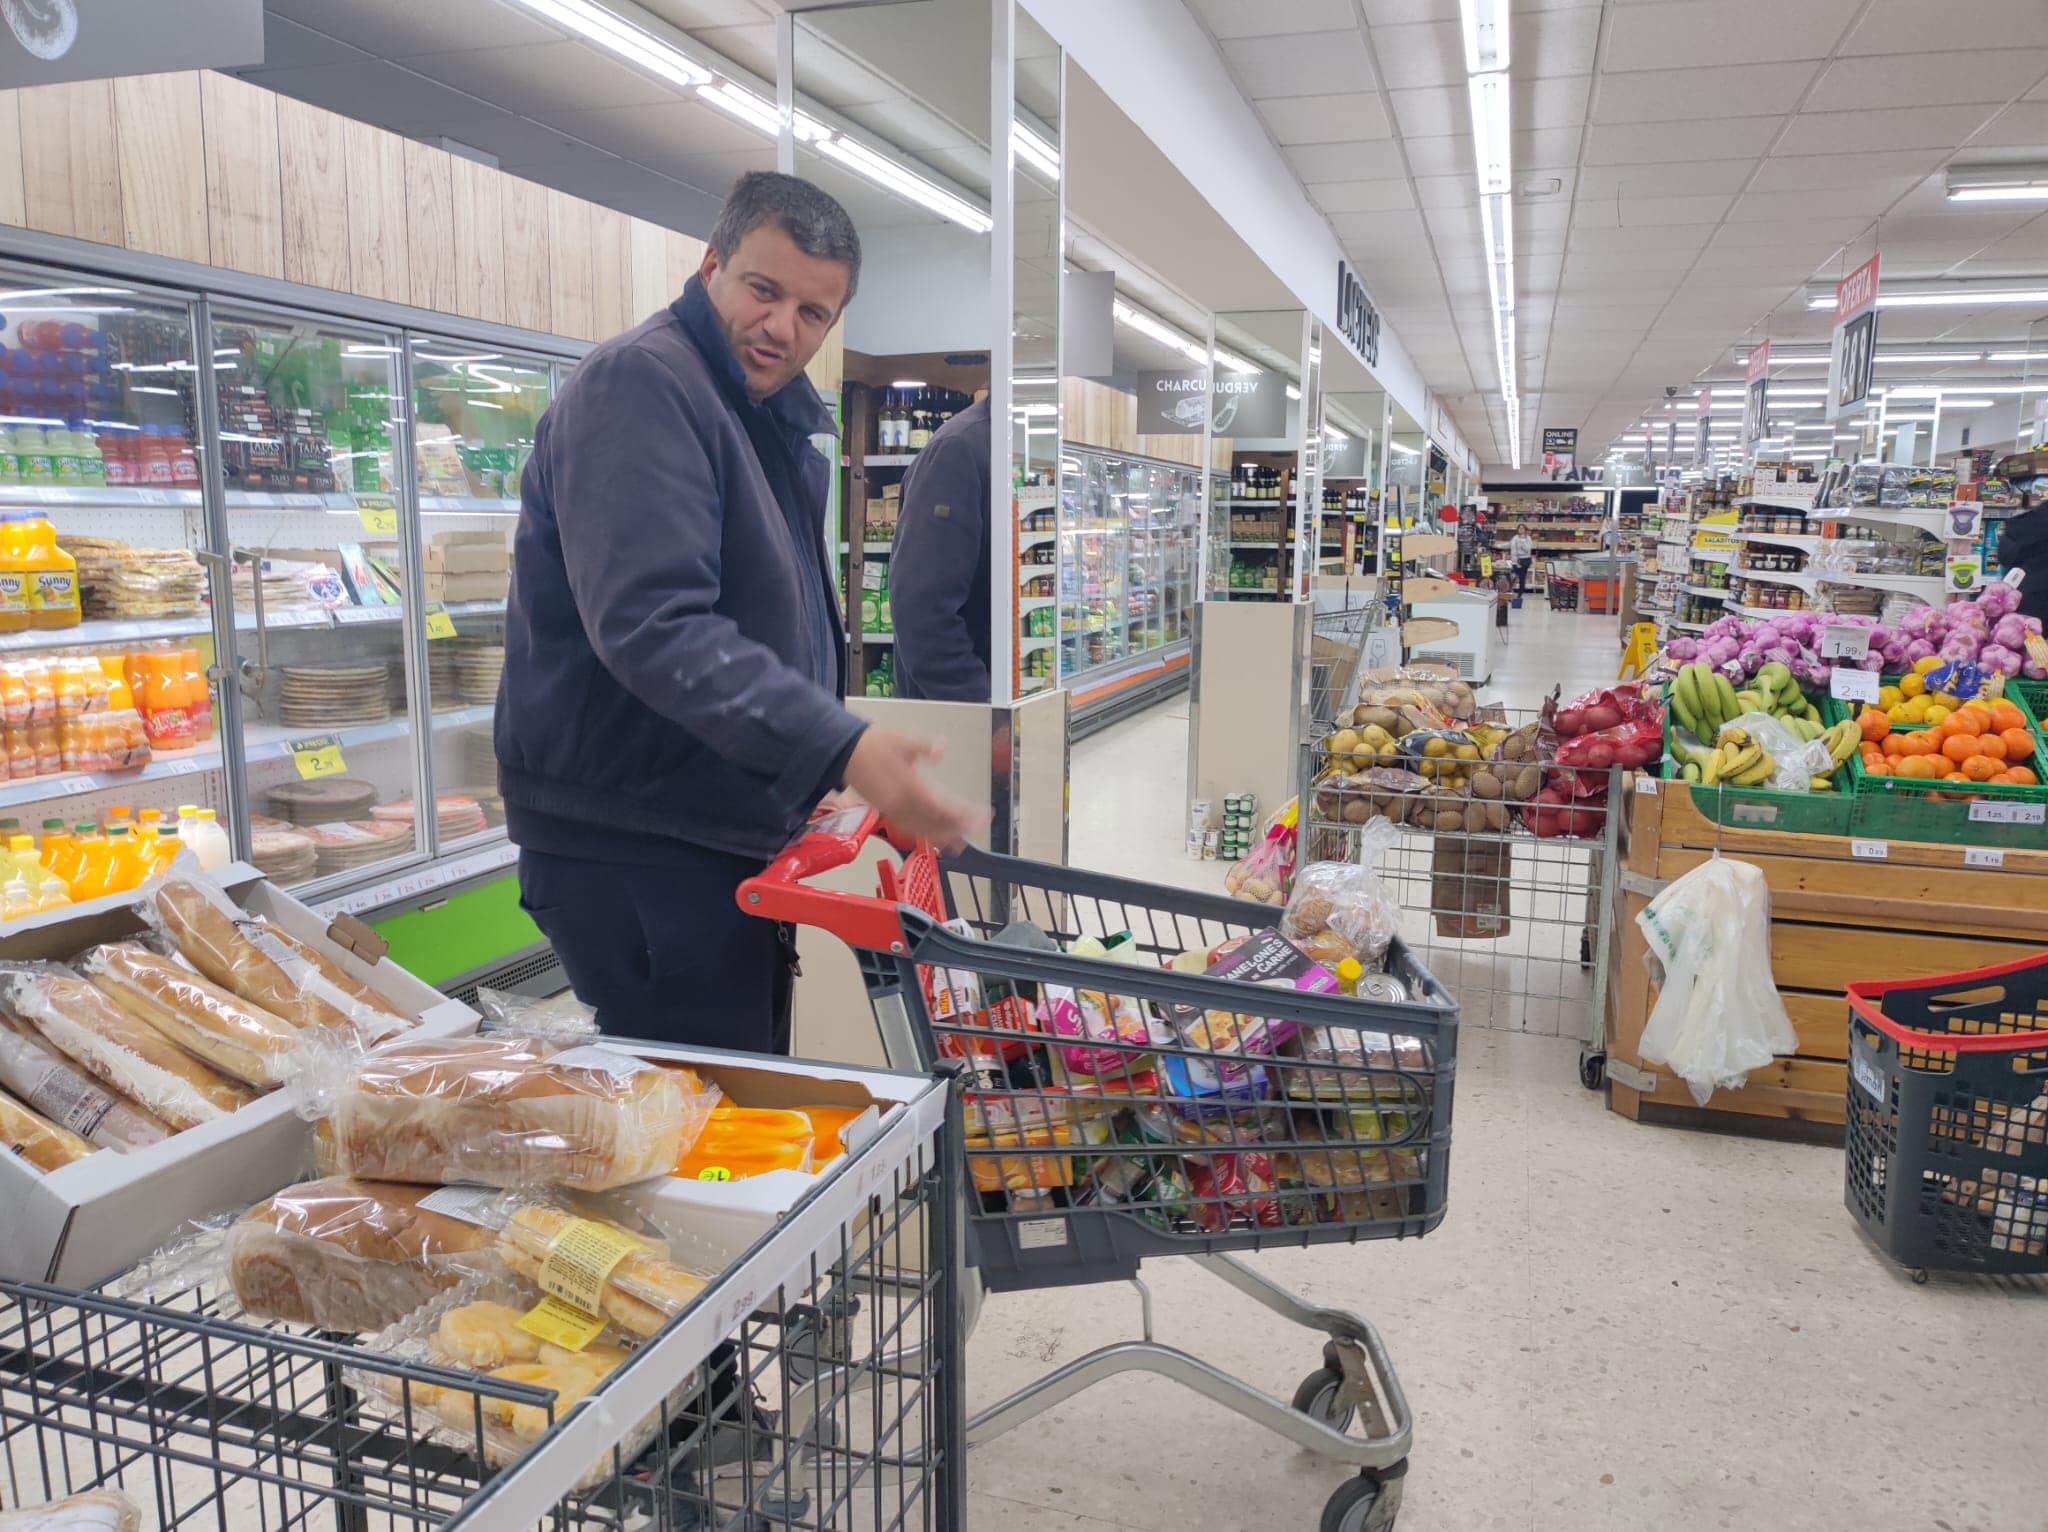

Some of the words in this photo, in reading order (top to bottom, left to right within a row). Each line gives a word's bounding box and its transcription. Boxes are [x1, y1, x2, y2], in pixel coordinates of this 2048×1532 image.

[1840, 265, 1872, 316] OFERTA
[1546, 430, 1574, 438] ONLINE
[1256, 945, 1294, 973] CARNE
